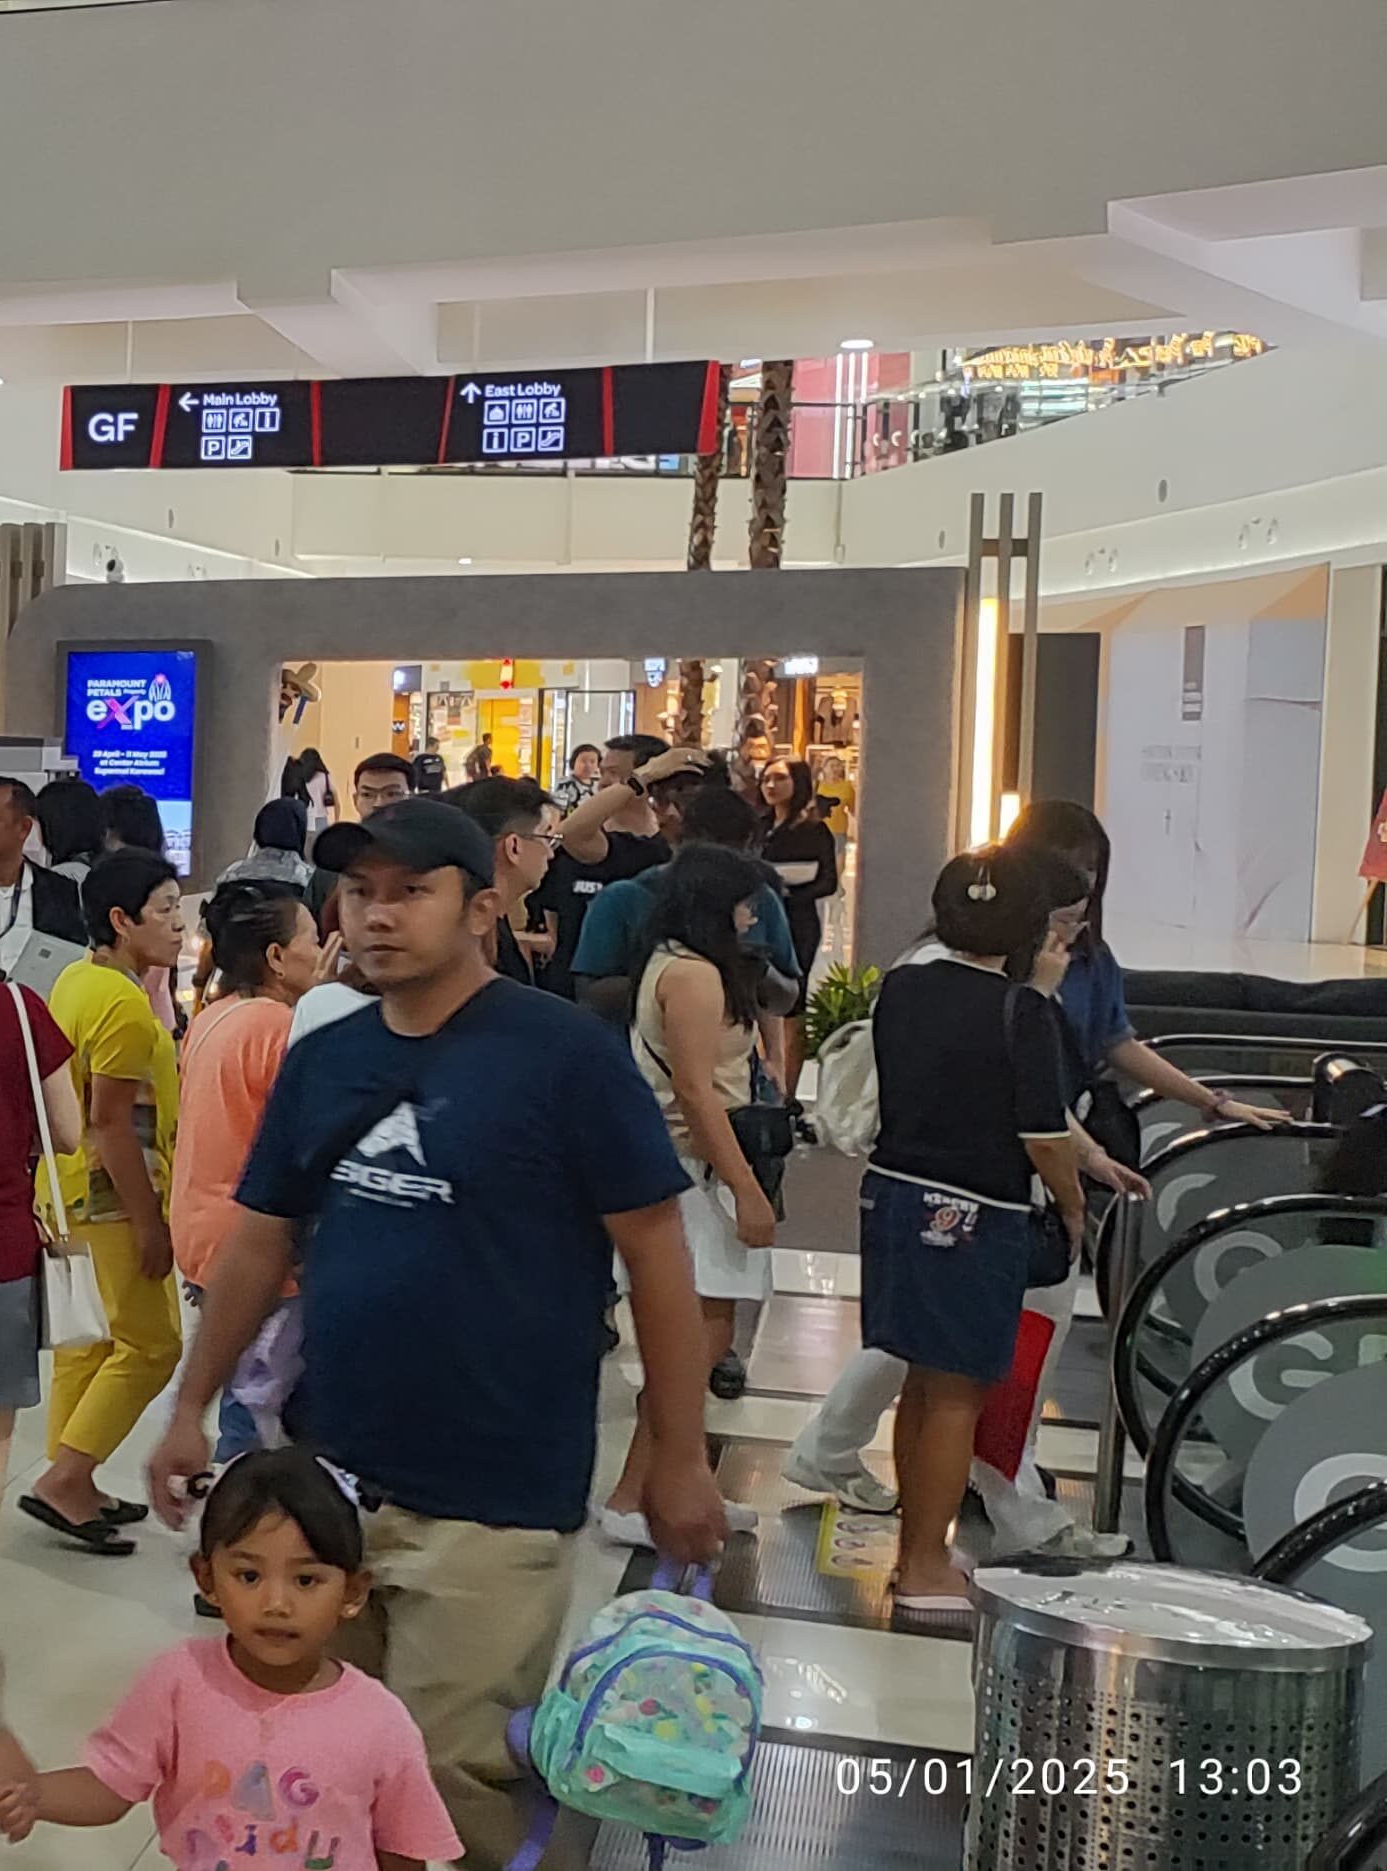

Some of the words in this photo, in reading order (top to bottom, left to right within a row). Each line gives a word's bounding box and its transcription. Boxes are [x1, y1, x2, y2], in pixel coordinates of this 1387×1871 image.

[485, 384, 515, 397] East
[518, 382, 561, 397] Lobby
[203, 393, 234, 406] Main
[236, 392, 277, 407] Lobby
[88, 412, 139, 442] GF
[87, 679, 147, 688] PARAMOUNT
[87, 688, 122, 696] PETALS
